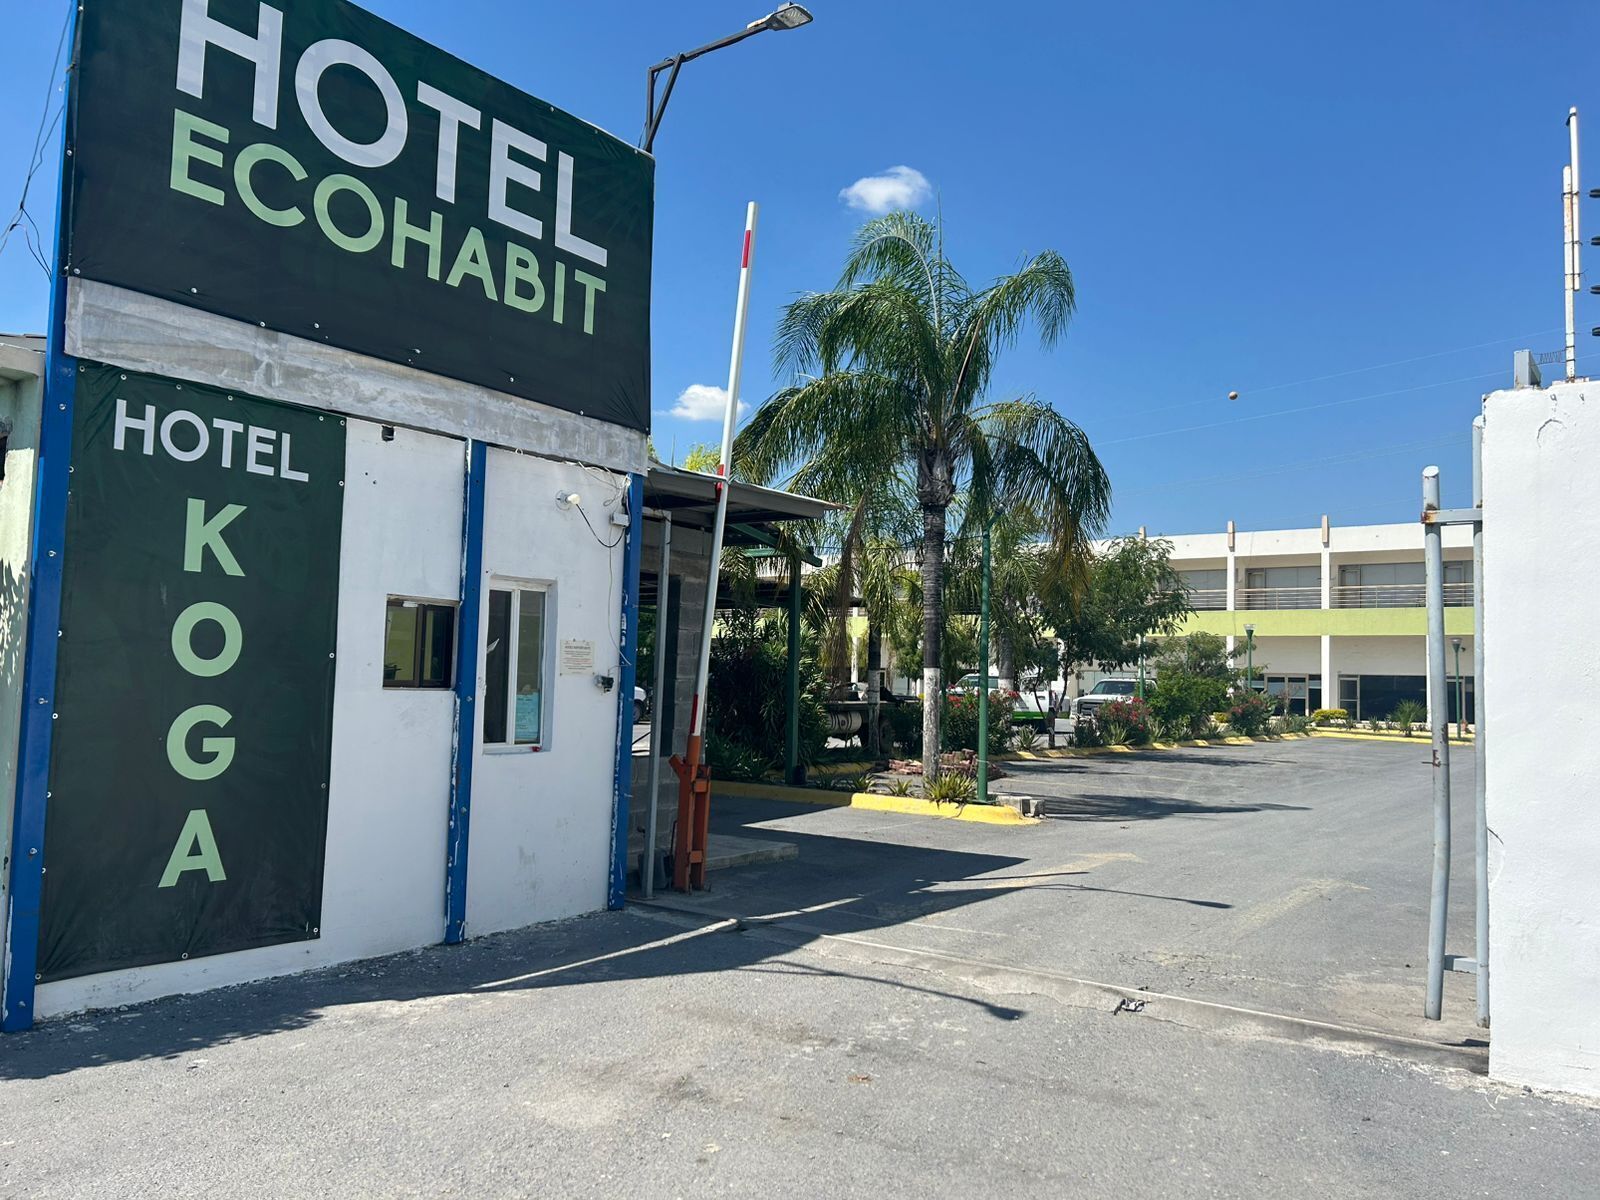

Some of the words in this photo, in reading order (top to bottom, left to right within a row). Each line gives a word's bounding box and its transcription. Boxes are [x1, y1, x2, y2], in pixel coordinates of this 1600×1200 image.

[170, 108, 607, 335] ECOHABIT
[176, 0, 608, 268] HOTEL
[112, 398, 310, 483] HOTEL
[158, 497, 248, 888] KOGA
